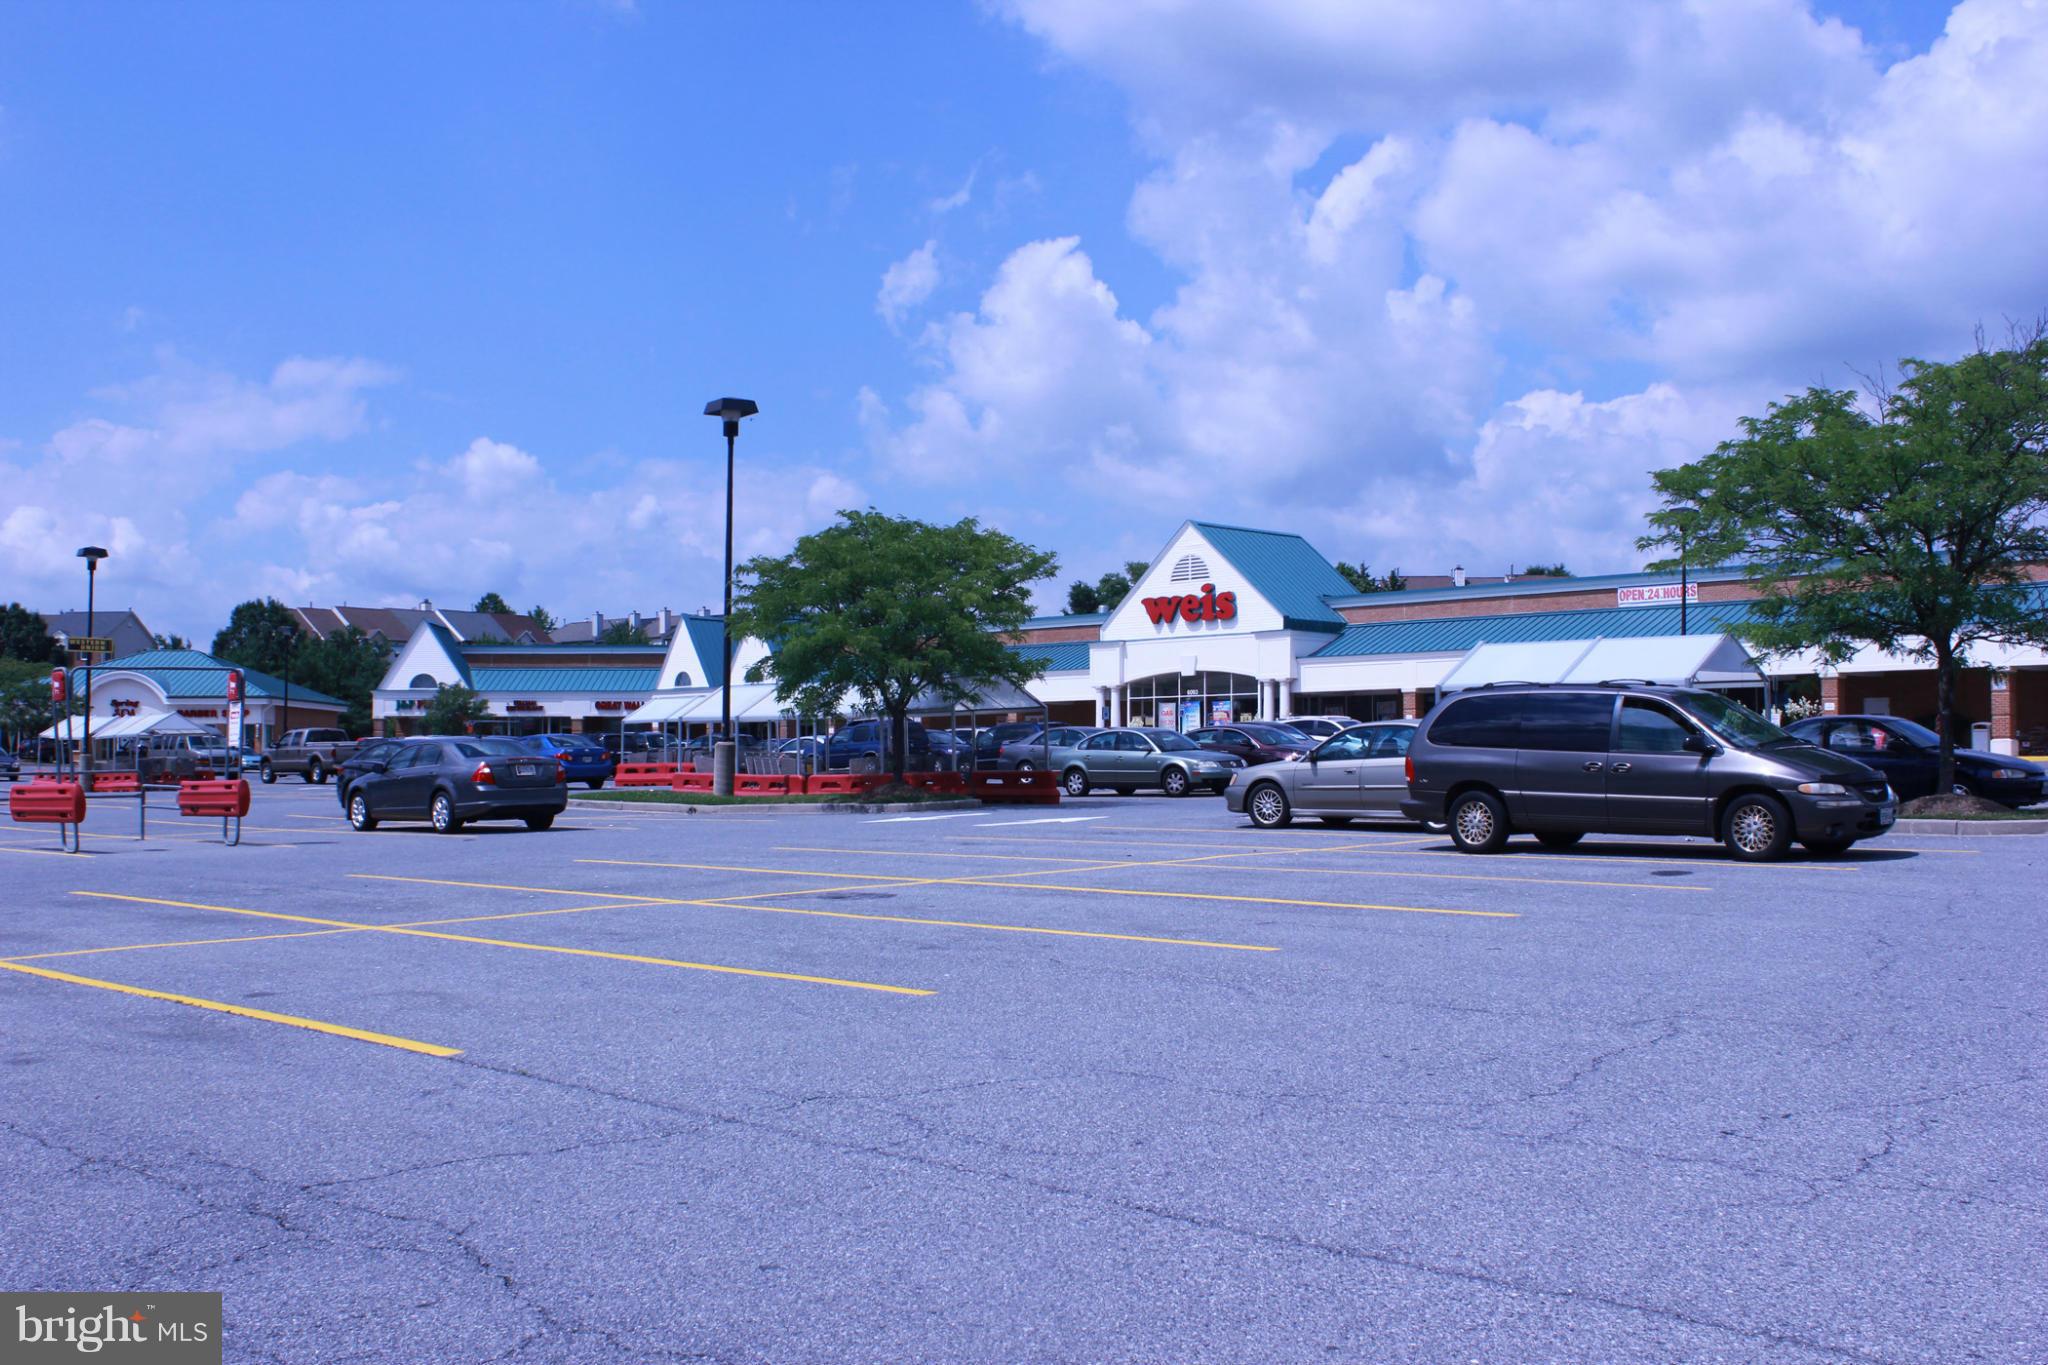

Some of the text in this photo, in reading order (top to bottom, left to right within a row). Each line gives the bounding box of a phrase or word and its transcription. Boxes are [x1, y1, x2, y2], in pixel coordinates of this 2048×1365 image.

[1619, 585, 1697, 602] OPEN 24 HOURS
[1141, 583, 1238, 626] weis
[595, 700, 622, 710] GREAT
